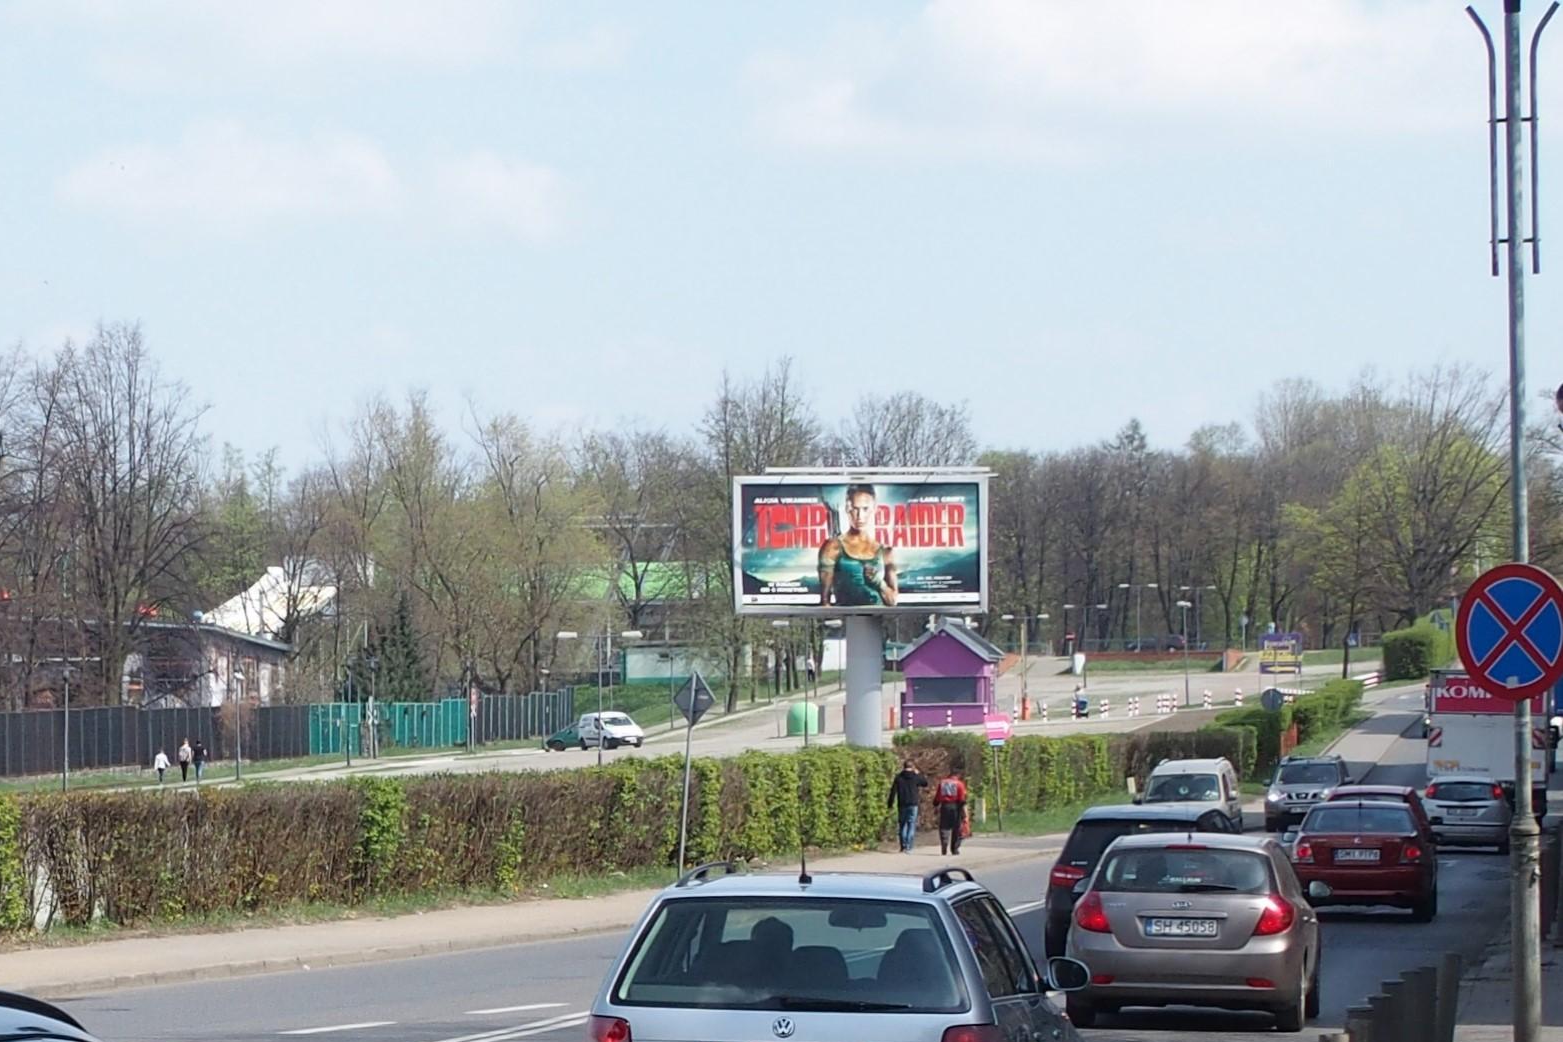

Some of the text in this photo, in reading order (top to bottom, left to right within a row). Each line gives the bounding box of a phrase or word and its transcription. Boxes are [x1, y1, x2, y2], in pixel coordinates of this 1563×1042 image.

[753, 503, 966, 549] TOMB RAIDER
[1154, 920, 1173, 932] SH
